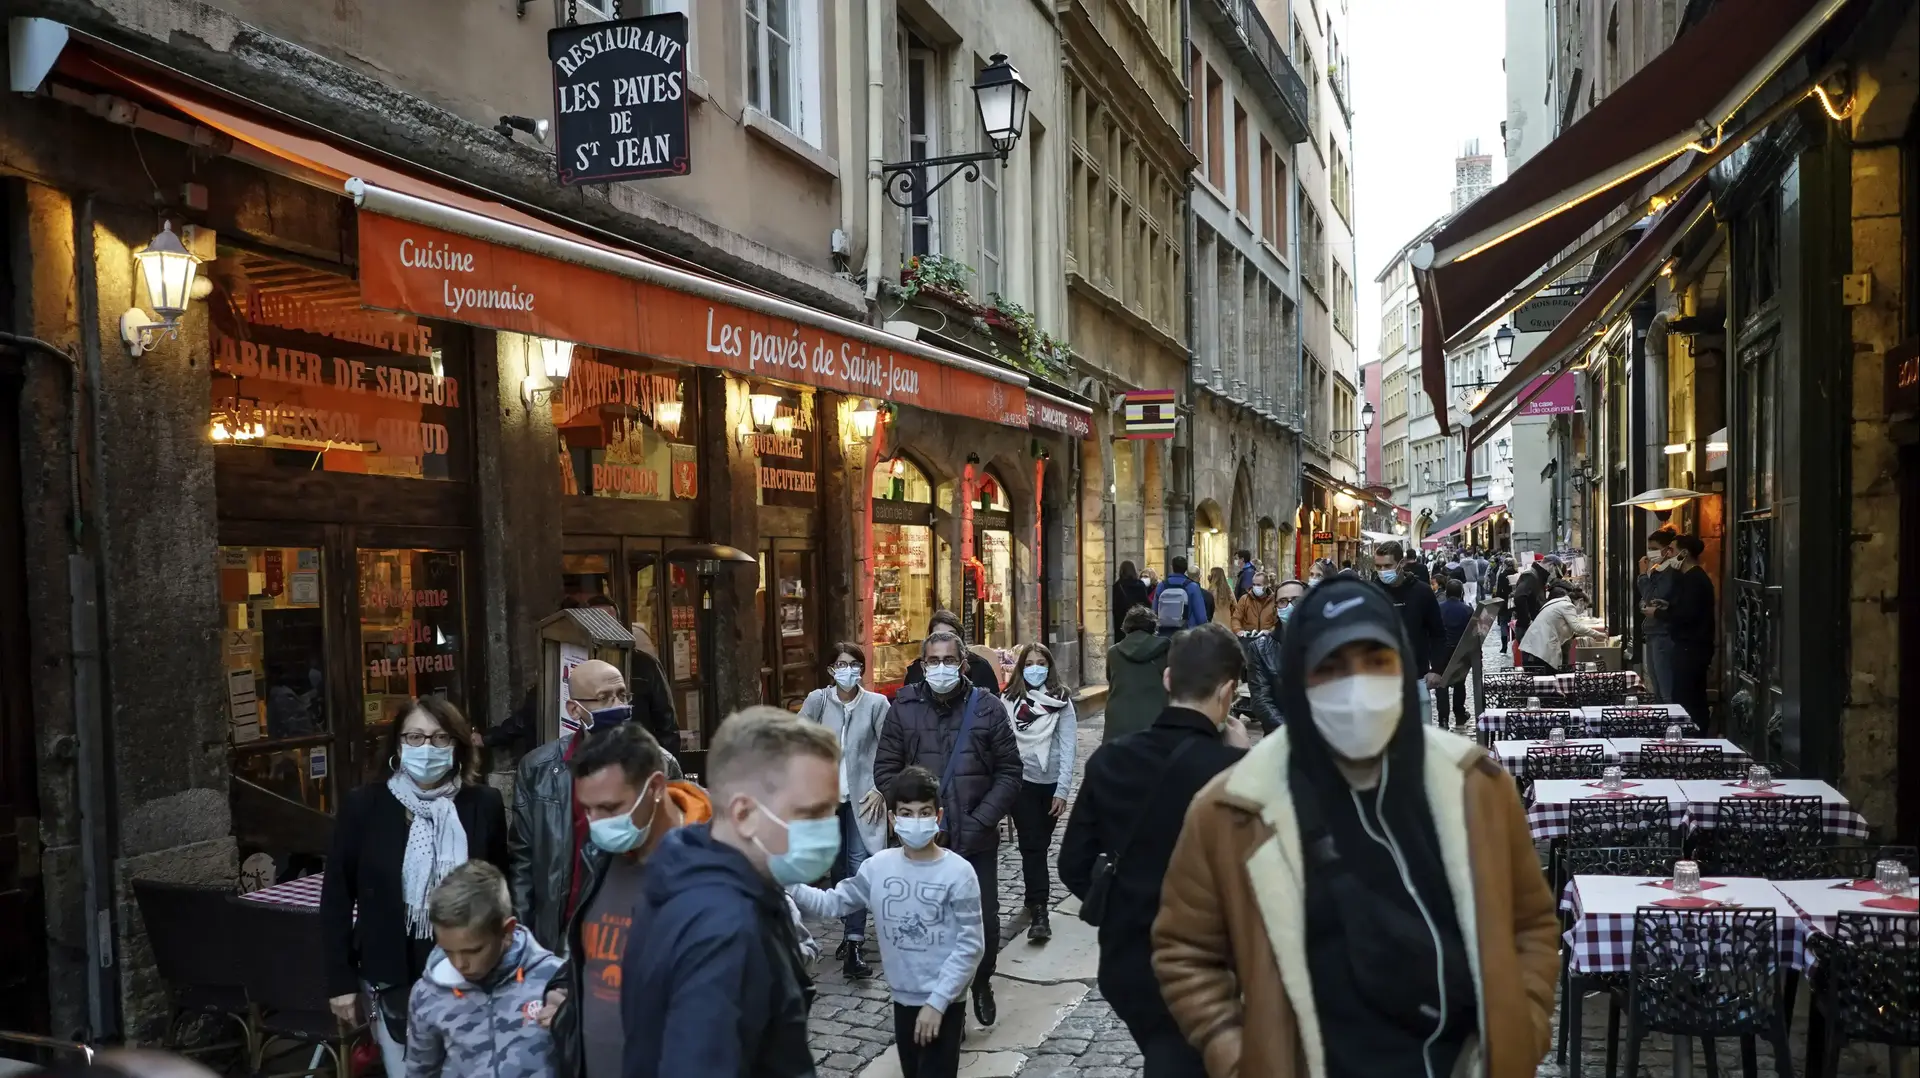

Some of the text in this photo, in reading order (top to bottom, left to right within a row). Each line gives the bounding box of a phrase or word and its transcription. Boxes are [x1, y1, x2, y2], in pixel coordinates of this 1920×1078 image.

[557, 26, 681, 77] RESTAURANT
[559, 71, 682, 113] LES PAVES
[610, 111, 632, 134] DE
[610, 134, 670, 167] JEAN
[400, 238, 474, 272] Cuisine
[444, 279, 534, 313] Lyonnaise
[706, 307, 919, 396] Les pavés de Saint-Jean
[333, 356, 366, 395] DE
[375, 365, 460, 408] SAPEUR
[562, 357, 582, 423] LES
[584, 360, 621, 407] PAVES
[624, 368, 639, 407] DE
[222, 397, 449, 455] SAUCISSON CHAUD
[1561, 405, 1574, 413] paul
[754, 433, 803, 459] QUENELLE
[593, 464, 658, 496] BOUCHON
[370, 654, 455, 677] au caveau
[882, 876, 946, 926] 25
